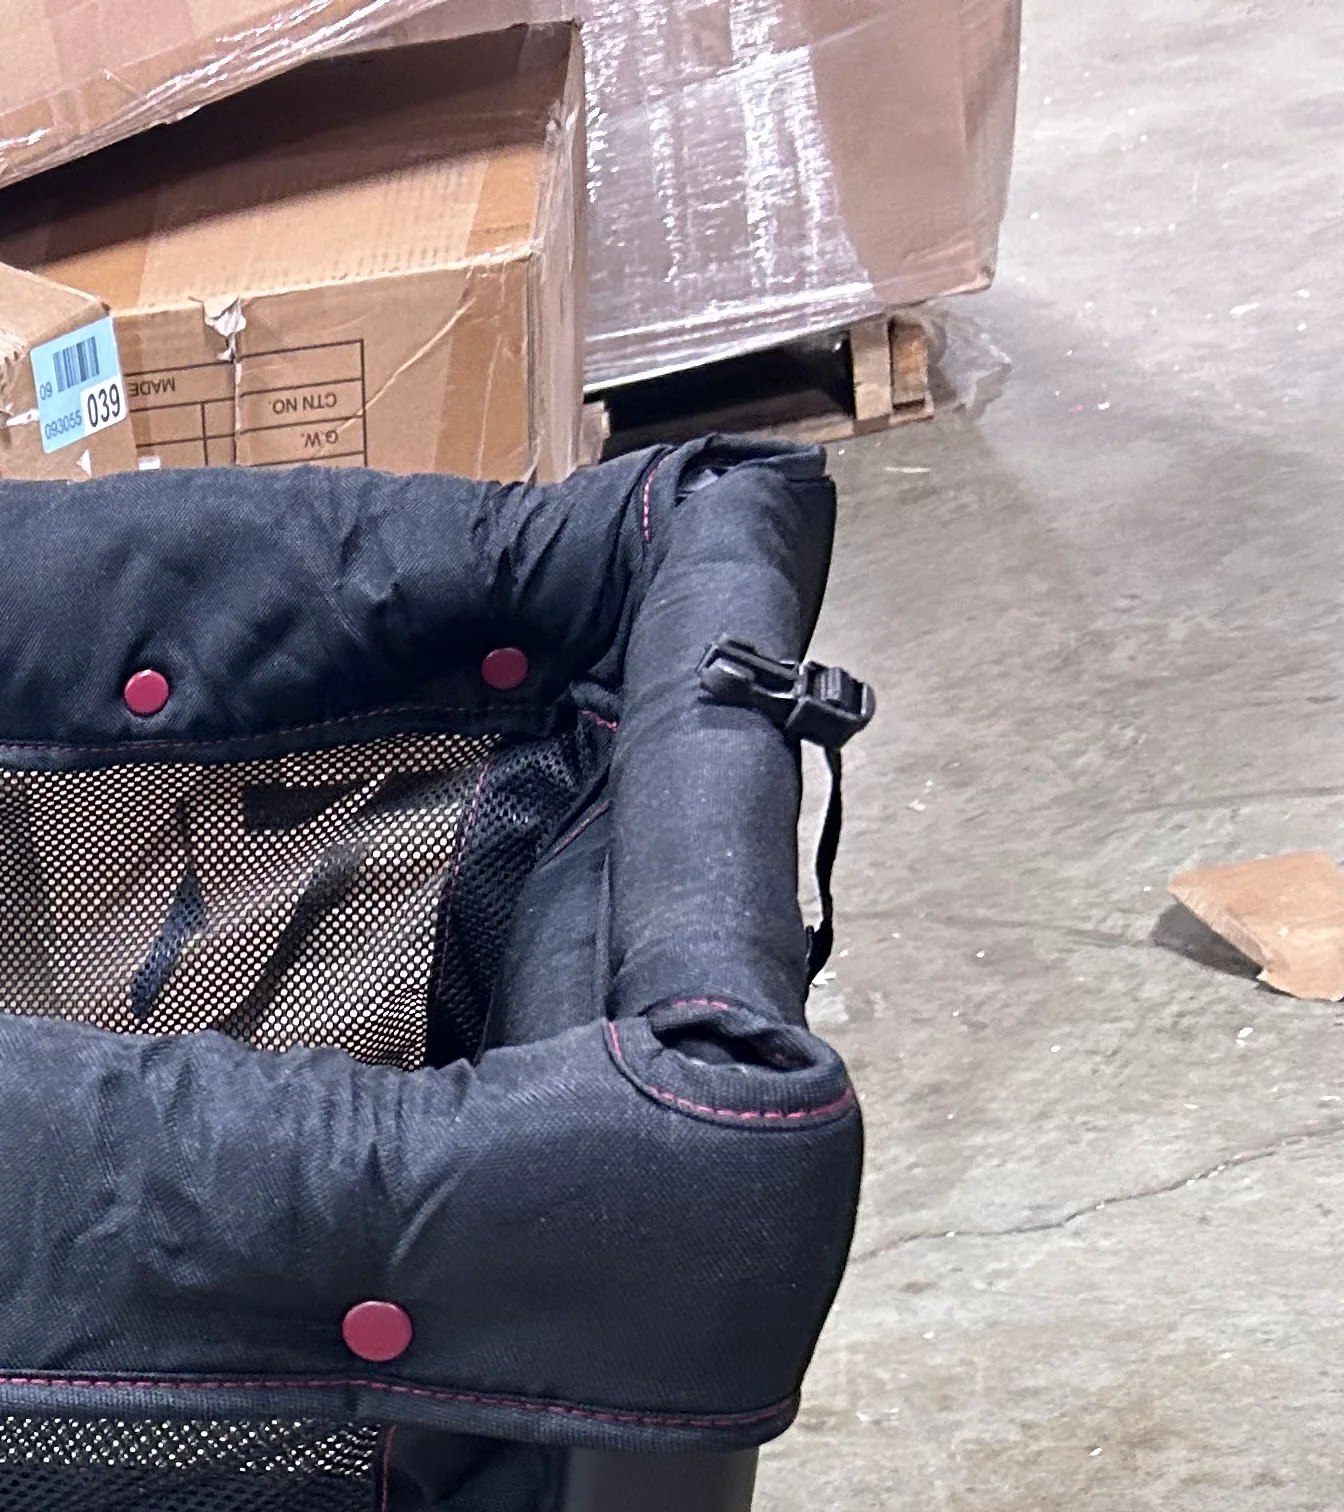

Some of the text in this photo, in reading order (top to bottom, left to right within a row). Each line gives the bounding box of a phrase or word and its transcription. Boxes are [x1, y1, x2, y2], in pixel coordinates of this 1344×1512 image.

[39, 381, 53, 401] 09
[128, 377, 176, 397] MADE
[87, 384, 121, 427] 039
[268, 392, 337, 414] CTN NO.
